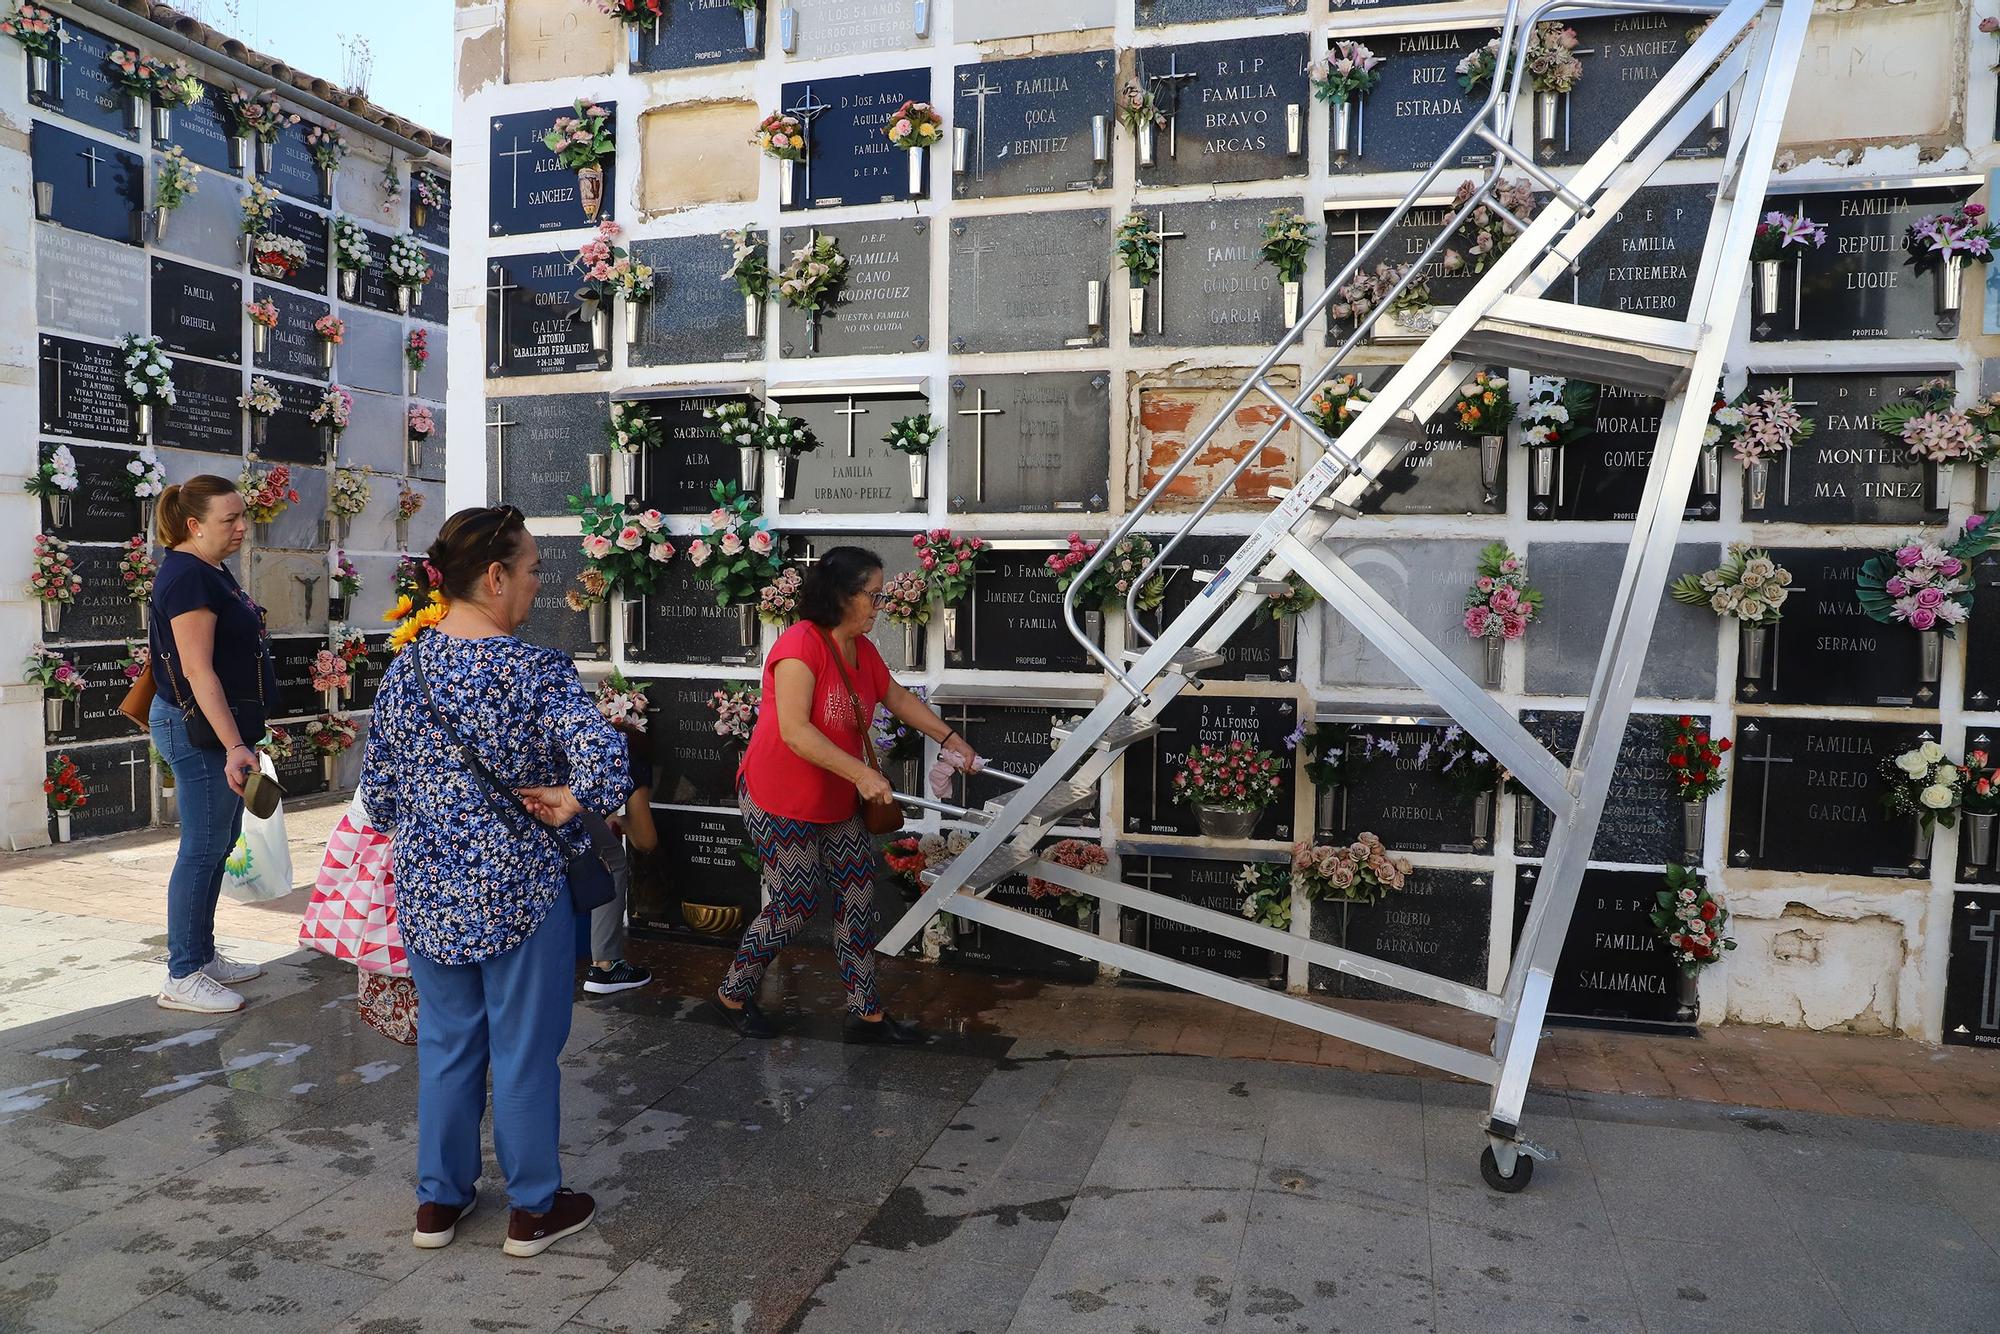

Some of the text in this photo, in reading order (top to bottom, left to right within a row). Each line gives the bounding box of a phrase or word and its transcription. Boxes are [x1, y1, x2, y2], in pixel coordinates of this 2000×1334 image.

[1613, 16, 1668, 32] FAMILIA
[78, 42, 110, 61] FAMILIA
[1398, 35, 1461, 53] FAMILIA
[1603, 40, 1678, 59] F SANCHEZ
[695, 50, 722, 60] PROPIEDAD
[80, 65, 108, 85] GARCIA
[1412, 67, 1447, 85] RUIZ
[1621, 66, 1659, 81] FIMIA
[1015, 79, 1069, 95] FAMILIA
[1202, 85, 1277, 103] FAMILIA
[76, 87, 113, 109] DEL ARCO
[853, 93, 904, 107] JOSE ABAD
[1395, 99, 1463, 118] ESTRADA
[194, 114, 214, 128] JOSEFA
[853, 113, 890, 126] AGUILAR
[1205, 110, 1268, 128] BRAVO
[180, 117, 227, 143] GARRIDO CASTRO
[869, 129, 875, 139] Y
[854, 145, 890, 155] FAMILIA
[1014, 137, 1069, 156] BENITEZ
[1203, 136, 1266, 155] ARCAS
[279, 163, 312, 182] JIMENEZ
[528, 187, 575, 205] SANCHEZ
[1840, 197, 1911, 217] FAMILIA
[539, 221, 562, 229] PROPIEDAD
[1622, 238, 1676, 253] FAMILIA
[1837, 235, 1910, 255] REPULLO
[848, 250, 900, 266] FAMILIA
[369, 268, 385, 280] LOPEZ
[532, 264, 574, 279] FAMILIA
[856, 272, 891, 284] CANO
[1608, 266, 1688, 282] EXTREMERA
[1847, 272, 1898, 290] LUQUE
[184, 284, 214, 302] FAMILIA
[535, 291, 570, 306] GOMEZ
[837, 286, 910, 302] RODRIGUEZ
[1619, 295, 1676, 311] PLATERO
[876, 309, 910, 321] FAMILIA
[1210, 307, 1261, 324] GARCIA
[180, 314, 216, 332] ORIHUELA
[288, 316, 315, 332] FAMILIA
[532, 319, 573, 336] GALVEZ
[844, 321, 903, 334] NO OS OLVIDA
[275, 329, 306, 346] PALACIOS
[537, 334, 566, 346] ANTONIO
[1852, 329, 1889, 337] PROPIEDAD
[288, 350, 317, 367] ESQUINA
[513, 343, 590, 359] CABALLERO FERNANDEZ
[72, 361, 99, 374] VAZQUEZ
[94, 357, 113, 367] REYES
[89, 381, 115, 392] ANTONIO
[75, 387, 94, 398] VIVAS
[95, 391, 122, 402] VAZQUEZ
[91, 406, 115, 416] CARMEN
[533, 407, 567, 419] FAMILIA
[680, 399, 718, 412] FAMILIA
[66, 411, 91, 423] JIMENEZ
[112, 418, 130, 427] TORRE
[530, 427, 570, 440] MARQUEZ
[673, 427, 723, 440] SACRISTAN
[547, 451, 553, 461] Y
[685, 454, 710, 466] ALBA
[1404, 456, 1433, 468] LUNA
[1817, 448, 1920, 465] MONTERO
[531, 472, 570, 485] MARQUEZ
[832, 465, 873, 478] FAMILIA
[89, 577, 126, 588] FAMILIA
[694, 580, 715, 592] JOSE
[82, 595, 132, 607] CASTRO
[984, 590, 1025, 604] JIMENEZ
[661, 605, 739, 620] BELLIDO MARTOS
[91, 614, 127, 627] RIVAS
[1008, 618, 1057, 629] Y FAMILIA
[1816, 637, 1877, 653] SERRANO
[286, 656, 309, 666] FAMILIA
[1015, 656, 1047, 665] PROPIEDAD
[1240, 647, 1271, 662] RIVAS
[92, 662, 122, 672] FAMILIA
[84, 678, 129, 689] CASTRO BAENA
[105, 693, 109, 701] Y
[83, 709, 106, 720] GARCIA
[1214, 717, 1260, 729] ALFONSO
[1004, 732, 1049, 746] ALCAIDE
[1199, 730, 1260, 744] COST MOYA
[1390, 731, 1439, 746] FAMILIA
[1806, 735, 1874, 756] FAMILIA
[675, 747, 721, 761] TORRALBA
[1806, 769, 1869, 789] PAREJO
[1409, 782, 1418, 796] Y
[92, 805, 125, 819] DELGADO
[1382, 806, 1444, 822] ARREBOLA
[1808, 803, 1868, 823] GARCIA
[700, 822, 726, 832] FAMILIA
[1151, 825, 1178, 834] PROPIEDAD
[684, 834, 743, 848] CARRERAS SANCHEZ
[1395, 842, 1427, 852] PROPIEDAD
[699, 845, 727, 856] Y JOSE
[691, 856, 736, 869] GOMEZ CALERO
[1190, 870, 1237, 886] FAMILIA
[1384, 911, 1431, 927] TORIBIO
[1375, 938, 1438, 955] BARRANCO
[1595, 933, 1655, 953] FAMILIA
[1579, 970, 1667, 995] SALAMANCA
